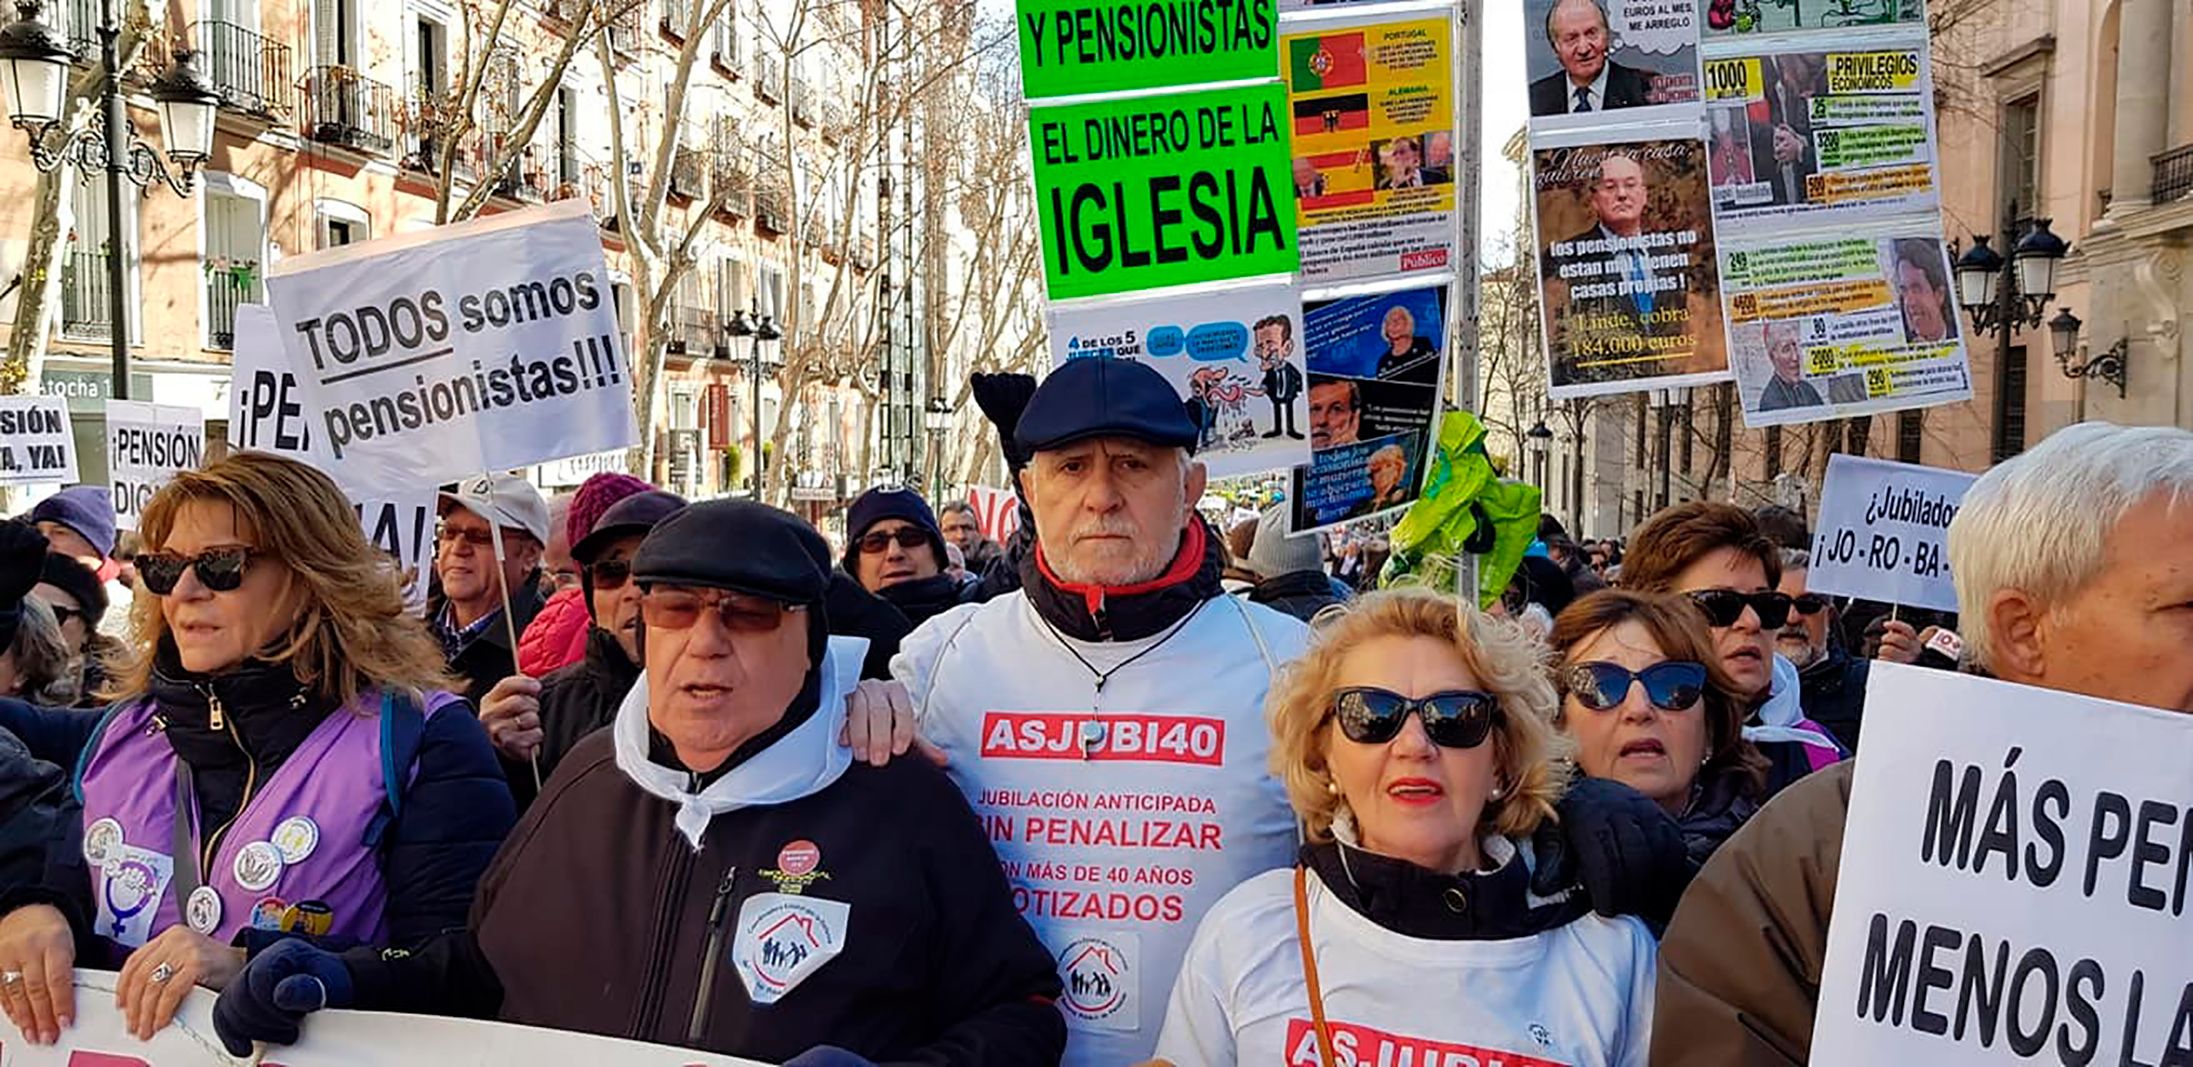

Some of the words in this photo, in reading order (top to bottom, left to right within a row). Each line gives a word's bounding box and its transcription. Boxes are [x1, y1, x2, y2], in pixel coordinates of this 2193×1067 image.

[1624, 4, 1656, 17] EUROS
[1027, 11, 1046, 67] Y
[1056, 0, 1271, 65] PENSIONISTAS
[1629, 20, 1643, 31] ME
[1707, 61, 1747, 90] 1000
[1835, 54, 1918, 76] PRIVILEGIOS
[1042, 121, 1079, 165] EL
[1084, 109, 1190, 161] DINERO
[1198, 105, 1235, 149] DE
[1242, 100, 1279, 145] LA
[1051, 165, 1285, 276] IGLESIA
[1550, 240, 1574, 257] los
[1576, 232, 1676, 255] pensionistas
[1677, 230, 1697, 244] no
[1560, 259, 1603, 278] estan
[1570, 282, 1616, 300] casas
[1618, 276, 1677, 295] propias
[296, 290, 450, 369] TODOS
[459, 272, 601, 333] somos
[1639, 306, 1690, 325] cobra
[1082, 338, 1098, 348] DE
[1100, 336, 1122, 347] LOS
[1125, 330, 1136, 344] 5
[1572, 335, 1644, 358] 184.000
[1645, 334, 1697, 351] euros
[324, 334, 621, 459] pensionistas!!!
[27, 445, 67, 471] YA!
[112, 425, 200, 471] ¡PENSIÓN
[1828, 528, 1855, 564] JO
[1867, 533, 1899, 570] RO
[1914, 541, 1939, 578] BA
[977, 788, 1089, 810] JUBILACIÓN
[1094, 793, 1217, 814] ANTICIPADA
[1921, 746, 2070, 888] MÁS
[1025, 817, 1223, 850] PENALIZAR
[1026, 861, 1068, 881] MÁS
[1074, 865, 1100, 882] DE
[1106, 866, 1129, 884] 40
[1135, 865, 1194, 885] AÑOS
[1012, 887, 1184, 922] OTIZADOS
[1857, 913, 2106, 1067] MENOS
